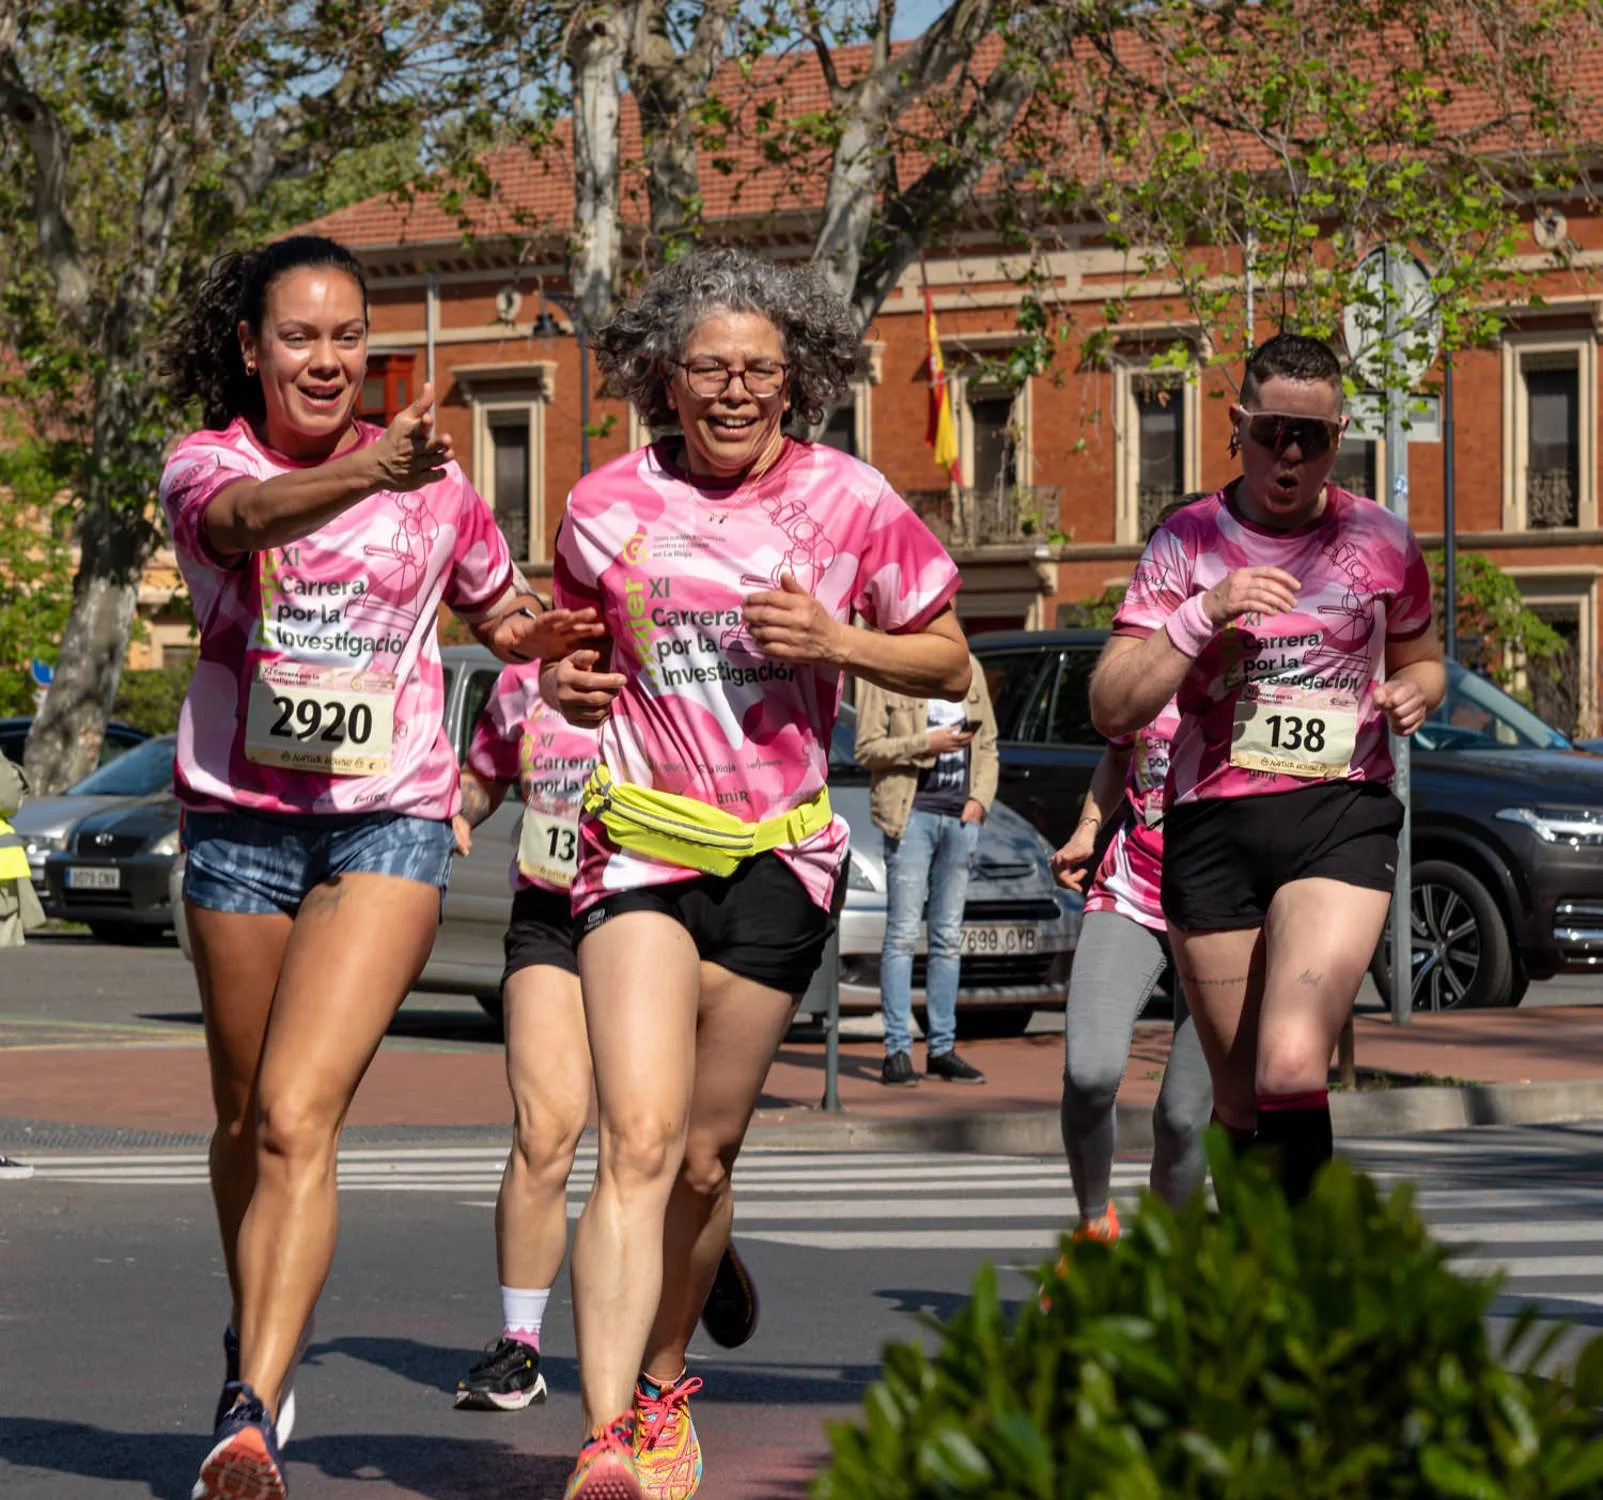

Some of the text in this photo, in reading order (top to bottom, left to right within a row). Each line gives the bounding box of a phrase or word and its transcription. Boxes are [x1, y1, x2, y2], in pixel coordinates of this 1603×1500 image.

[280, 547, 299, 566] XI
[280, 576, 365, 596] Carrera
[649, 577, 670, 599] XI
[278, 604, 341, 624] por la
[651, 607, 739, 628] Carrera
[1243, 612, 1261, 627] XI
[276, 627, 405, 658] Investigació
[656, 632, 719, 665] por la
[1243, 633, 1320, 649] Carrera
[1243, 654, 1299, 674] por la
[270, 696, 373, 744] 2920
[539, 733, 554, 748] XI
[1265, 715, 1326, 753] 138
[533, 754, 597, 769] Carrera
[534, 776, 579, 793] por la
